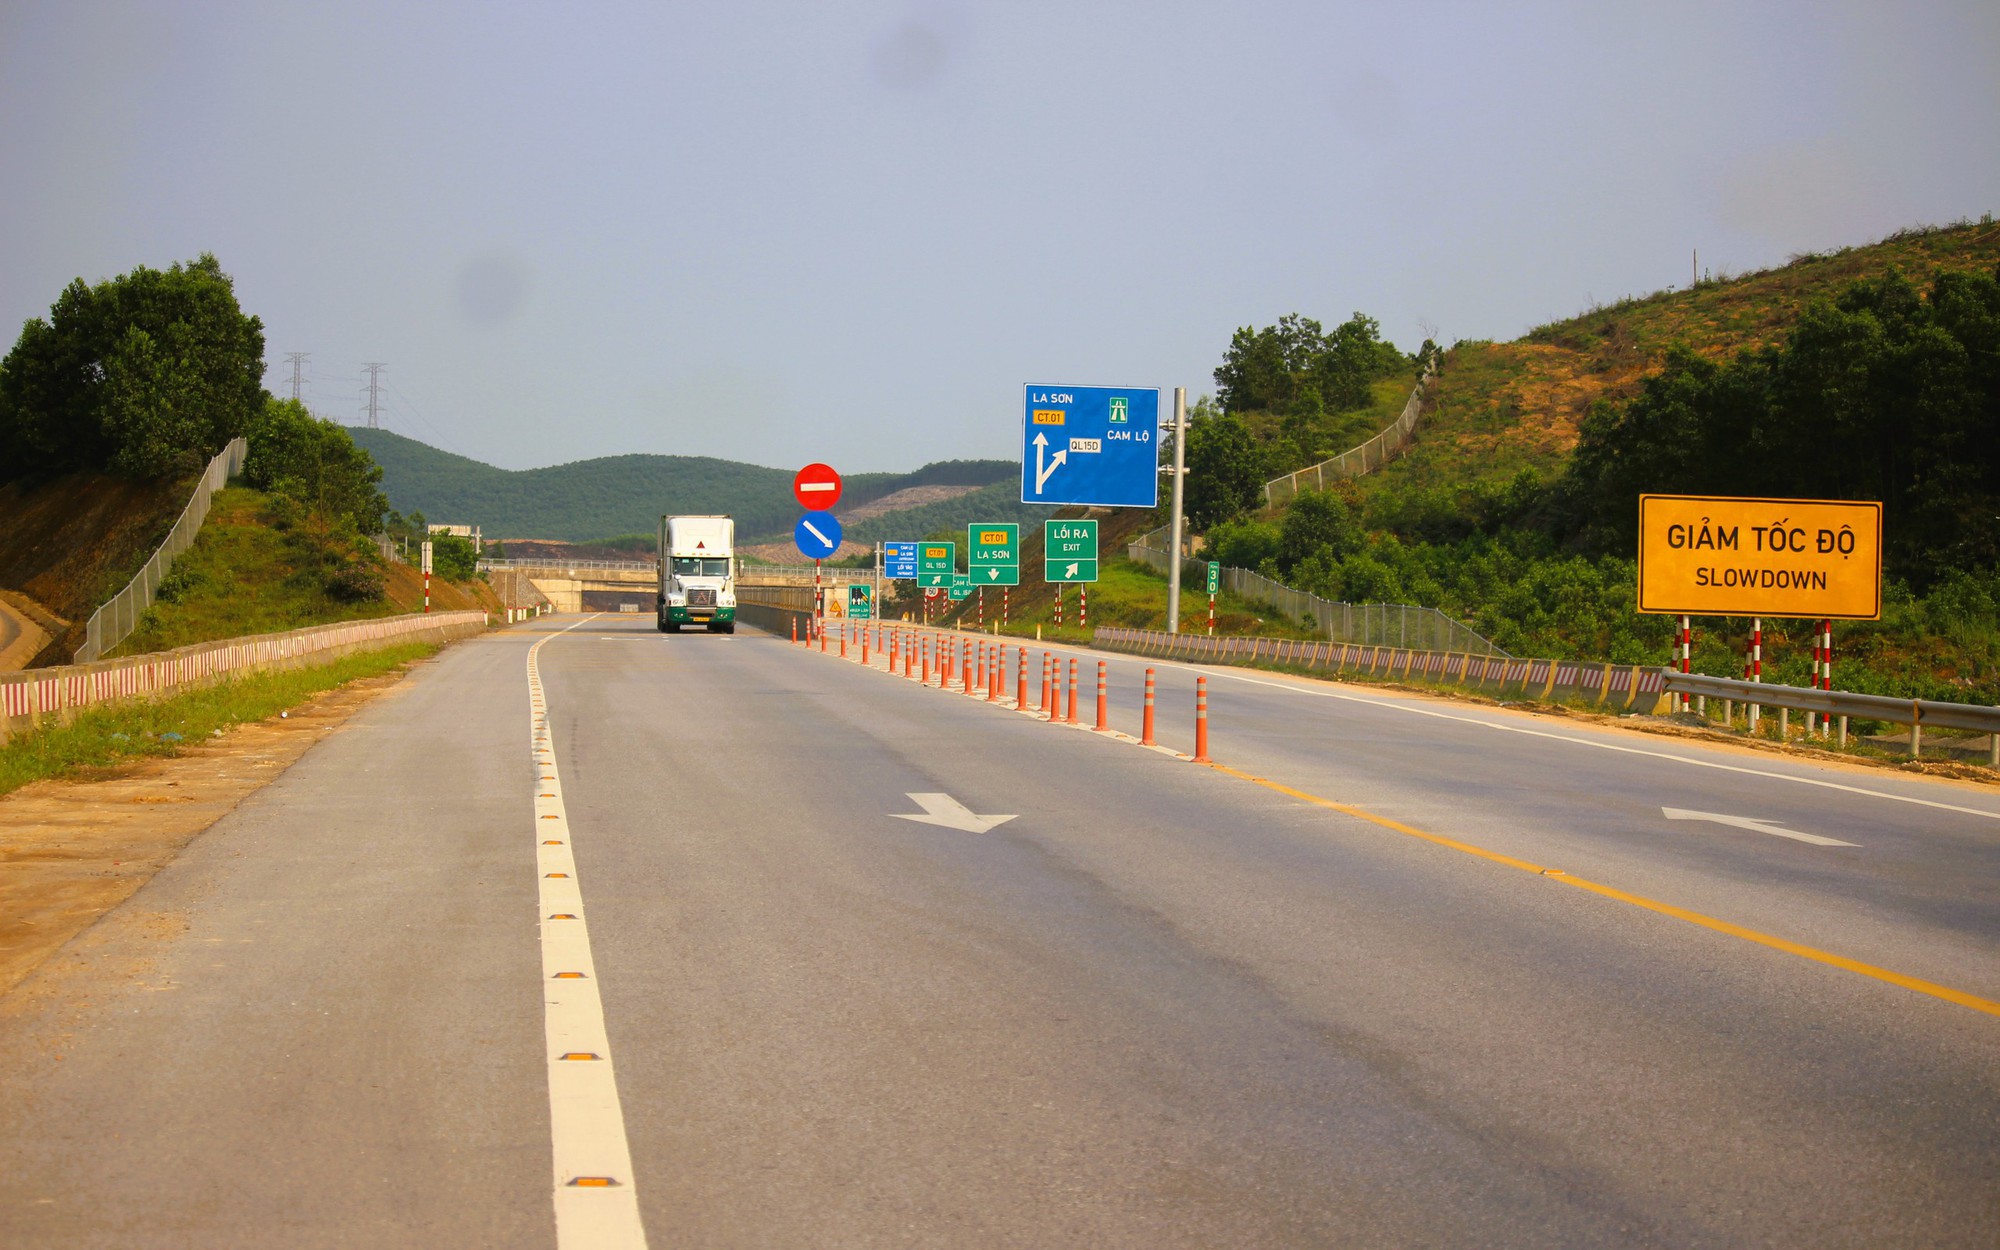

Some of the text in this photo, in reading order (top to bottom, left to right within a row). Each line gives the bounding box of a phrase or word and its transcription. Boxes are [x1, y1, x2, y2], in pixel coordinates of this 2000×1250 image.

[1033, 393, 1073, 404] LA SƠN
[1038, 412, 1060, 422] CT.01
[1107, 430, 1150, 443] CAM LỘ
[1054, 524, 1088, 538] LỐI RA
[984, 534, 1004, 542] CT.01
[1668, 516, 1855, 560] GIẢM TỐC ĐỘ
[992, 550, 1010, 559] SƠN
[1696, 568, 1826, 590] SLOWDOWN
